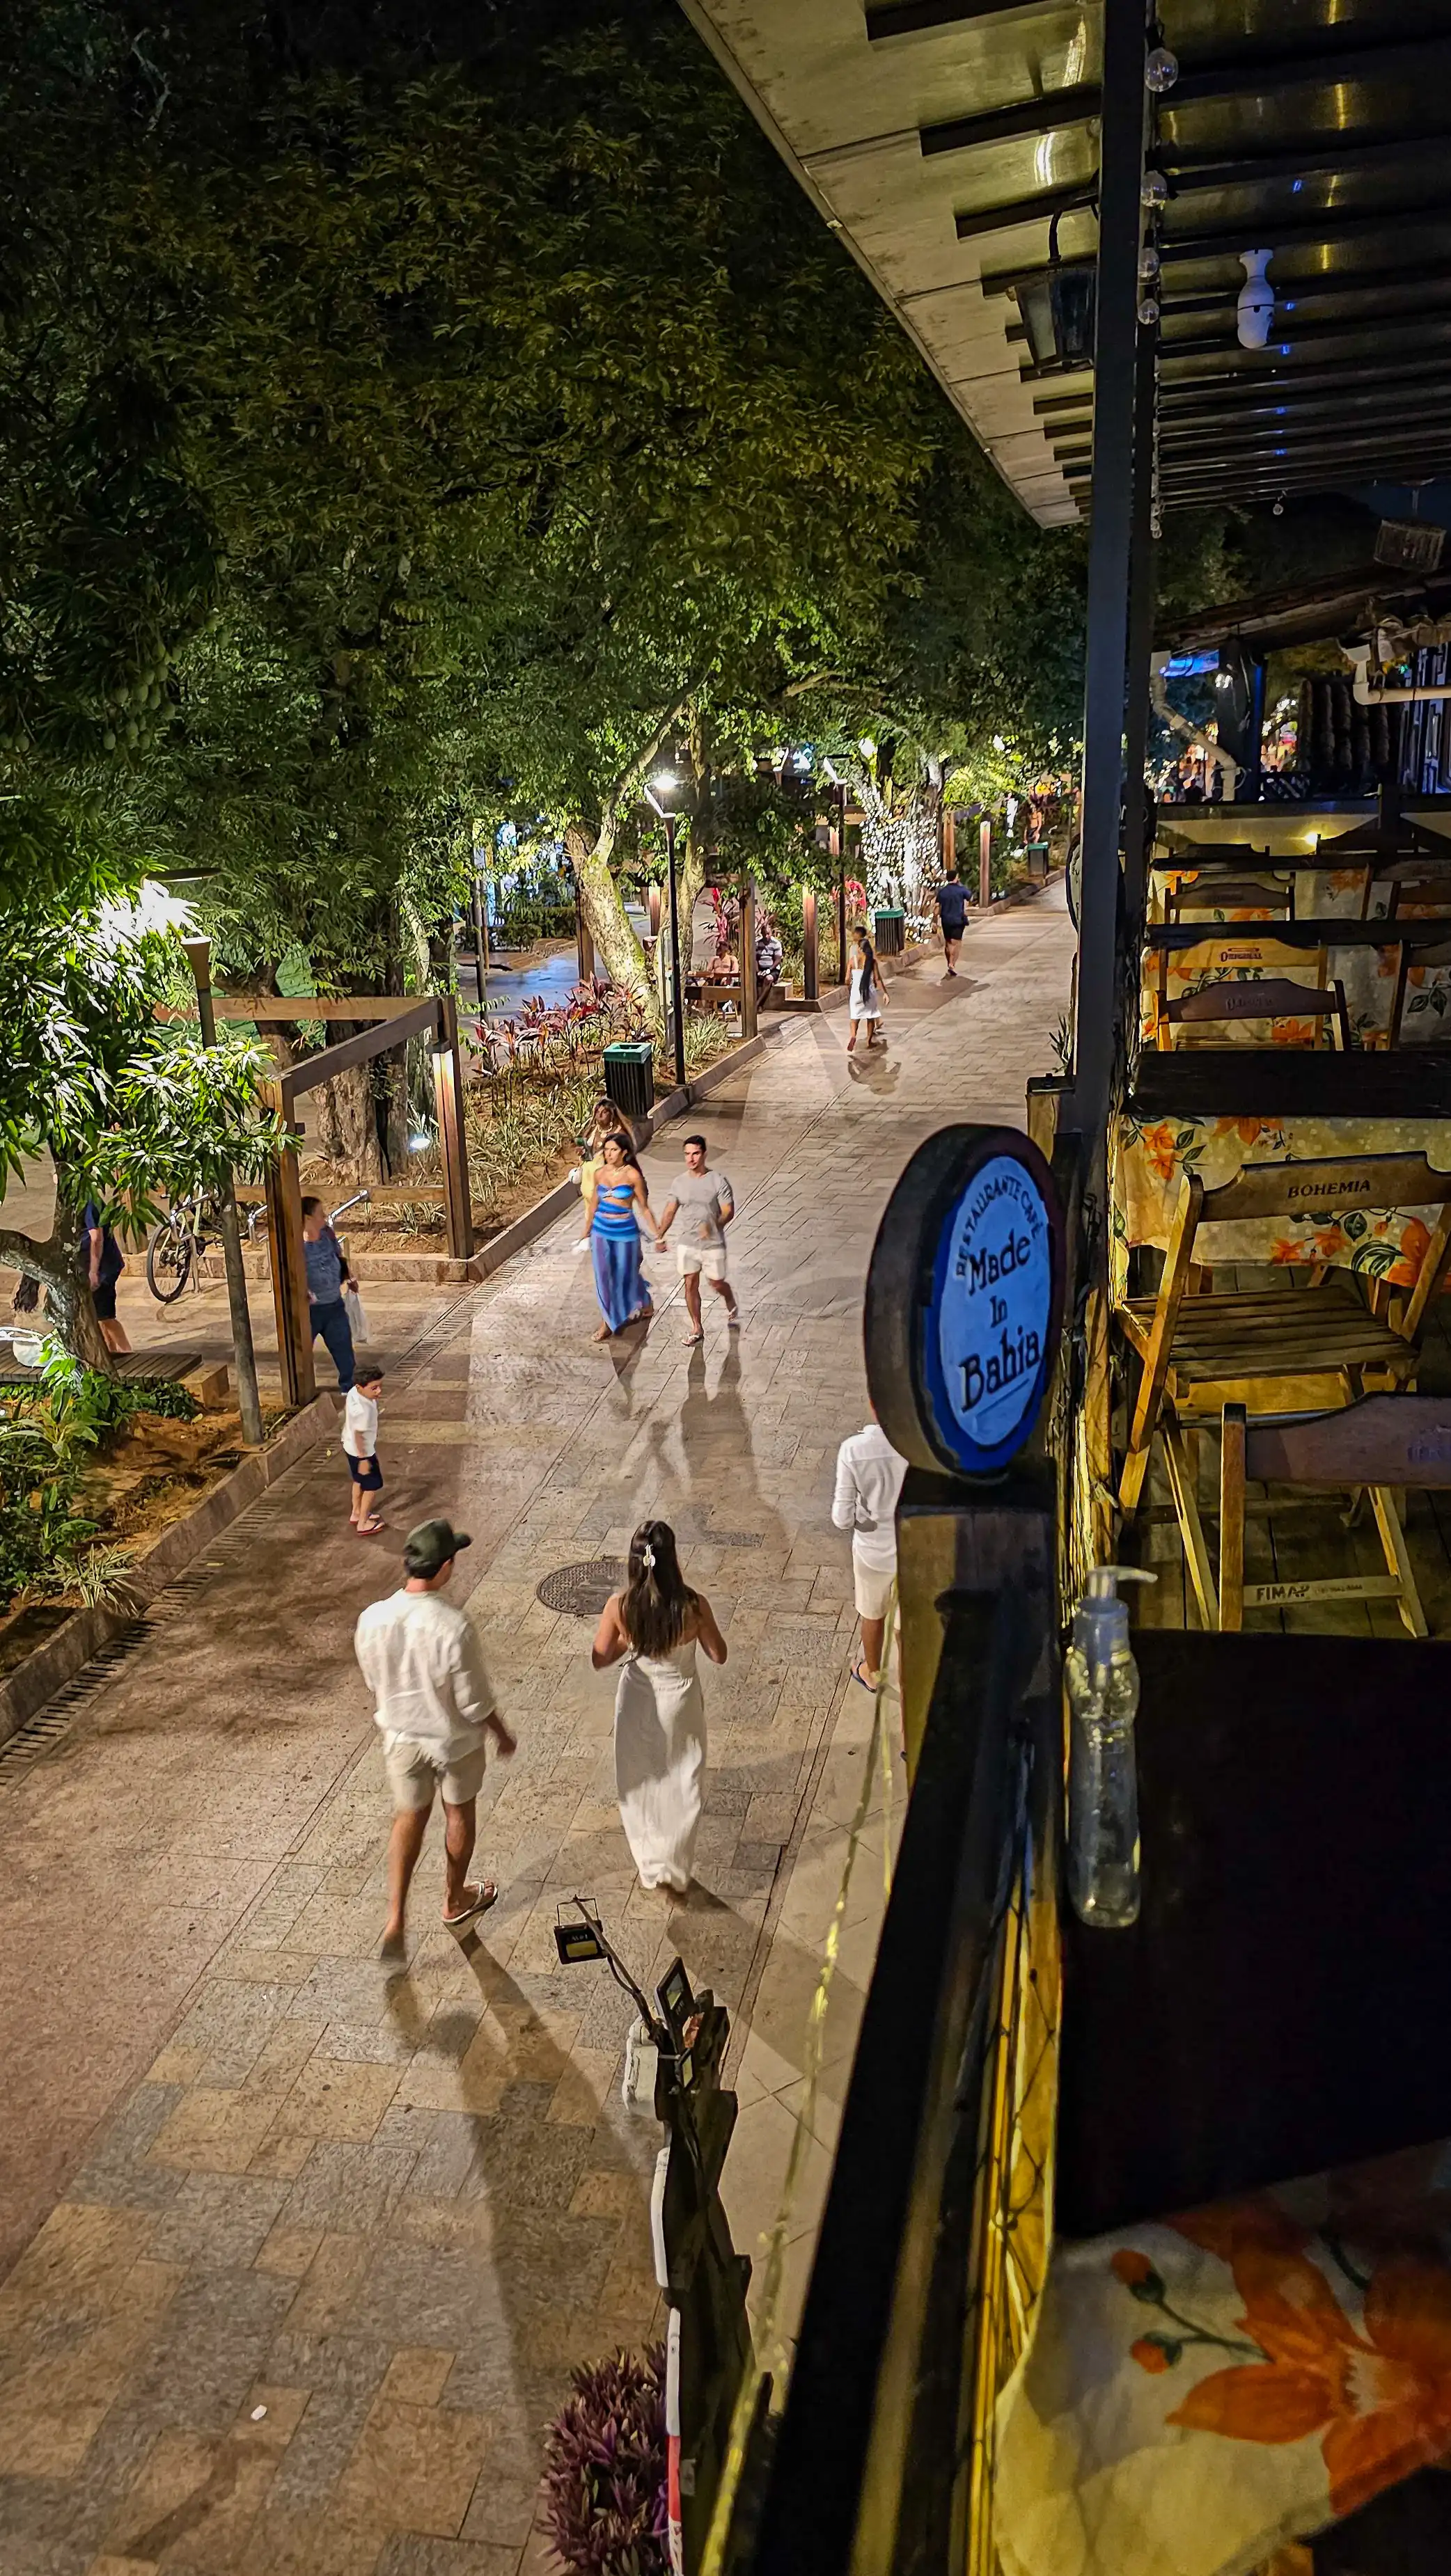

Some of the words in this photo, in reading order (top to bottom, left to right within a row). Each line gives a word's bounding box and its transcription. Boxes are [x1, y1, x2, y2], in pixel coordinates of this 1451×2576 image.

[956, 1175, 1022, 1277] RESTAURANTE
[1287, 1179, 1371, 1199] BOHEMIA
[968, 1227, 1031, 1296] Made
[959, 1325, 1042, 1412] Bahia
